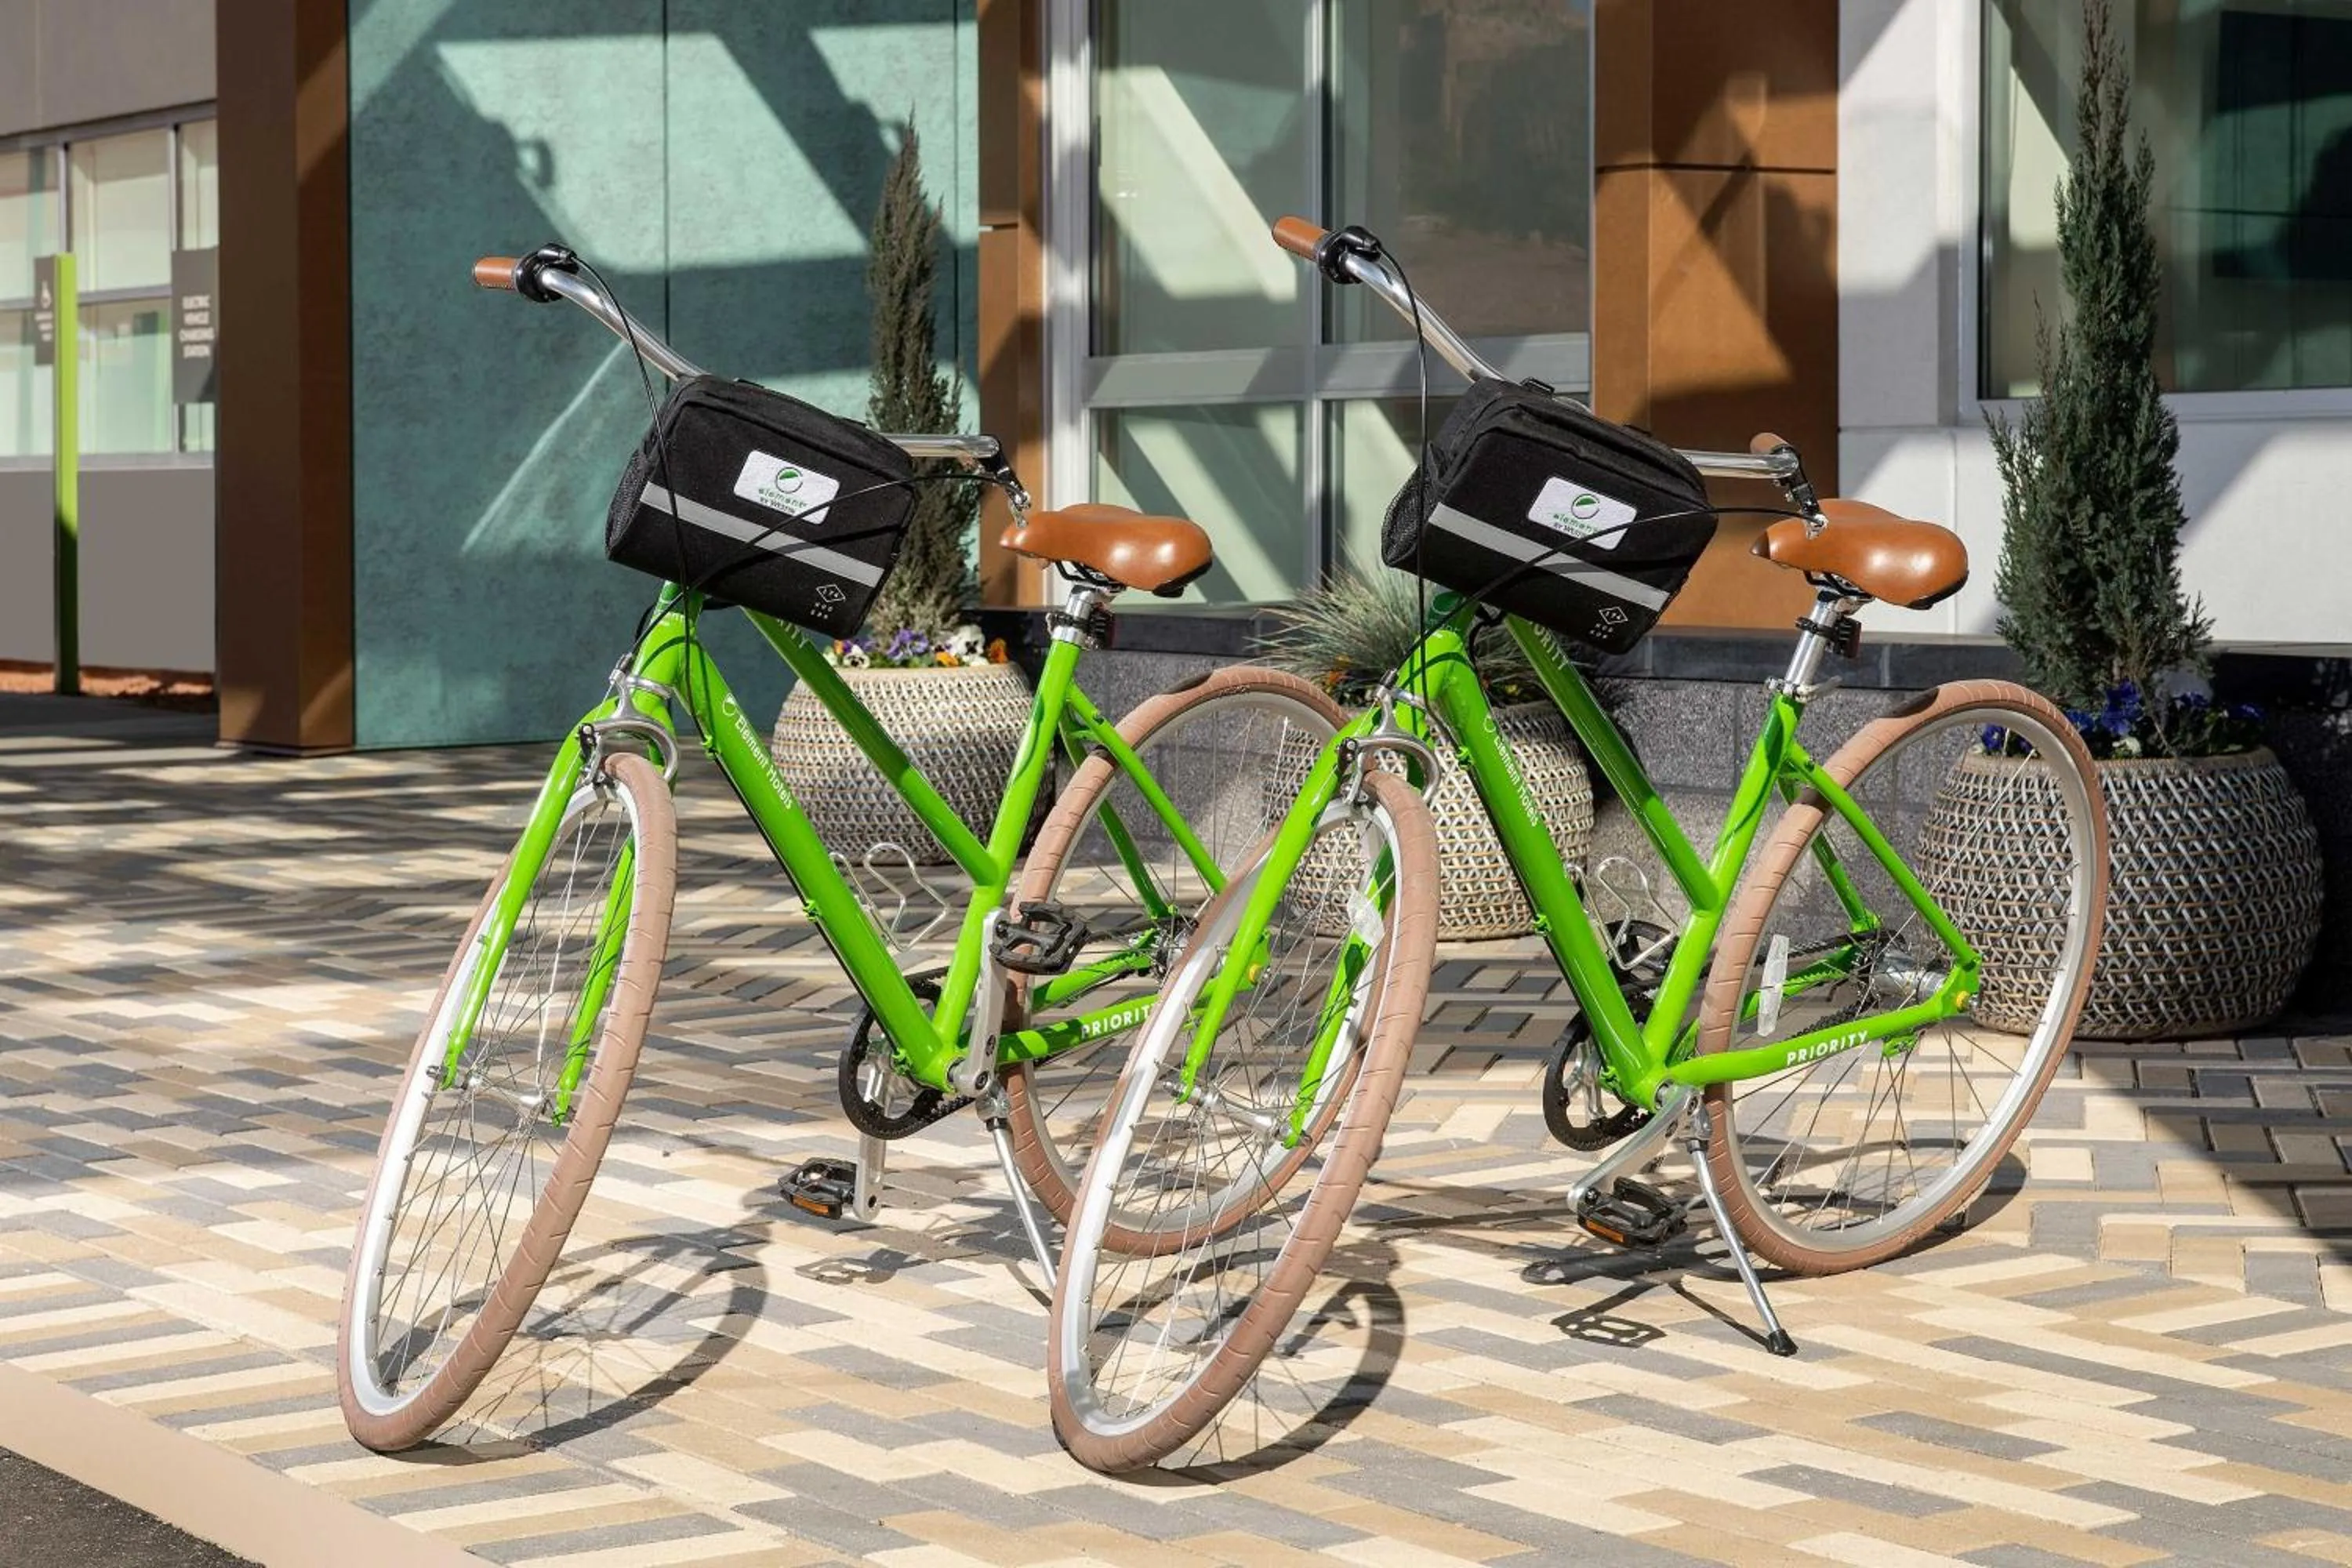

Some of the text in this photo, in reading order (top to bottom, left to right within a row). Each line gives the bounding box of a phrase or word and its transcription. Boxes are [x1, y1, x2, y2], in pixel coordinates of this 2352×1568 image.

[735, 714, 793, 810] Element Hotels
[1081, 1003, 1155, 1040] PRIORIT
[1787, 1029, 1867, 1065] PRIORITY
